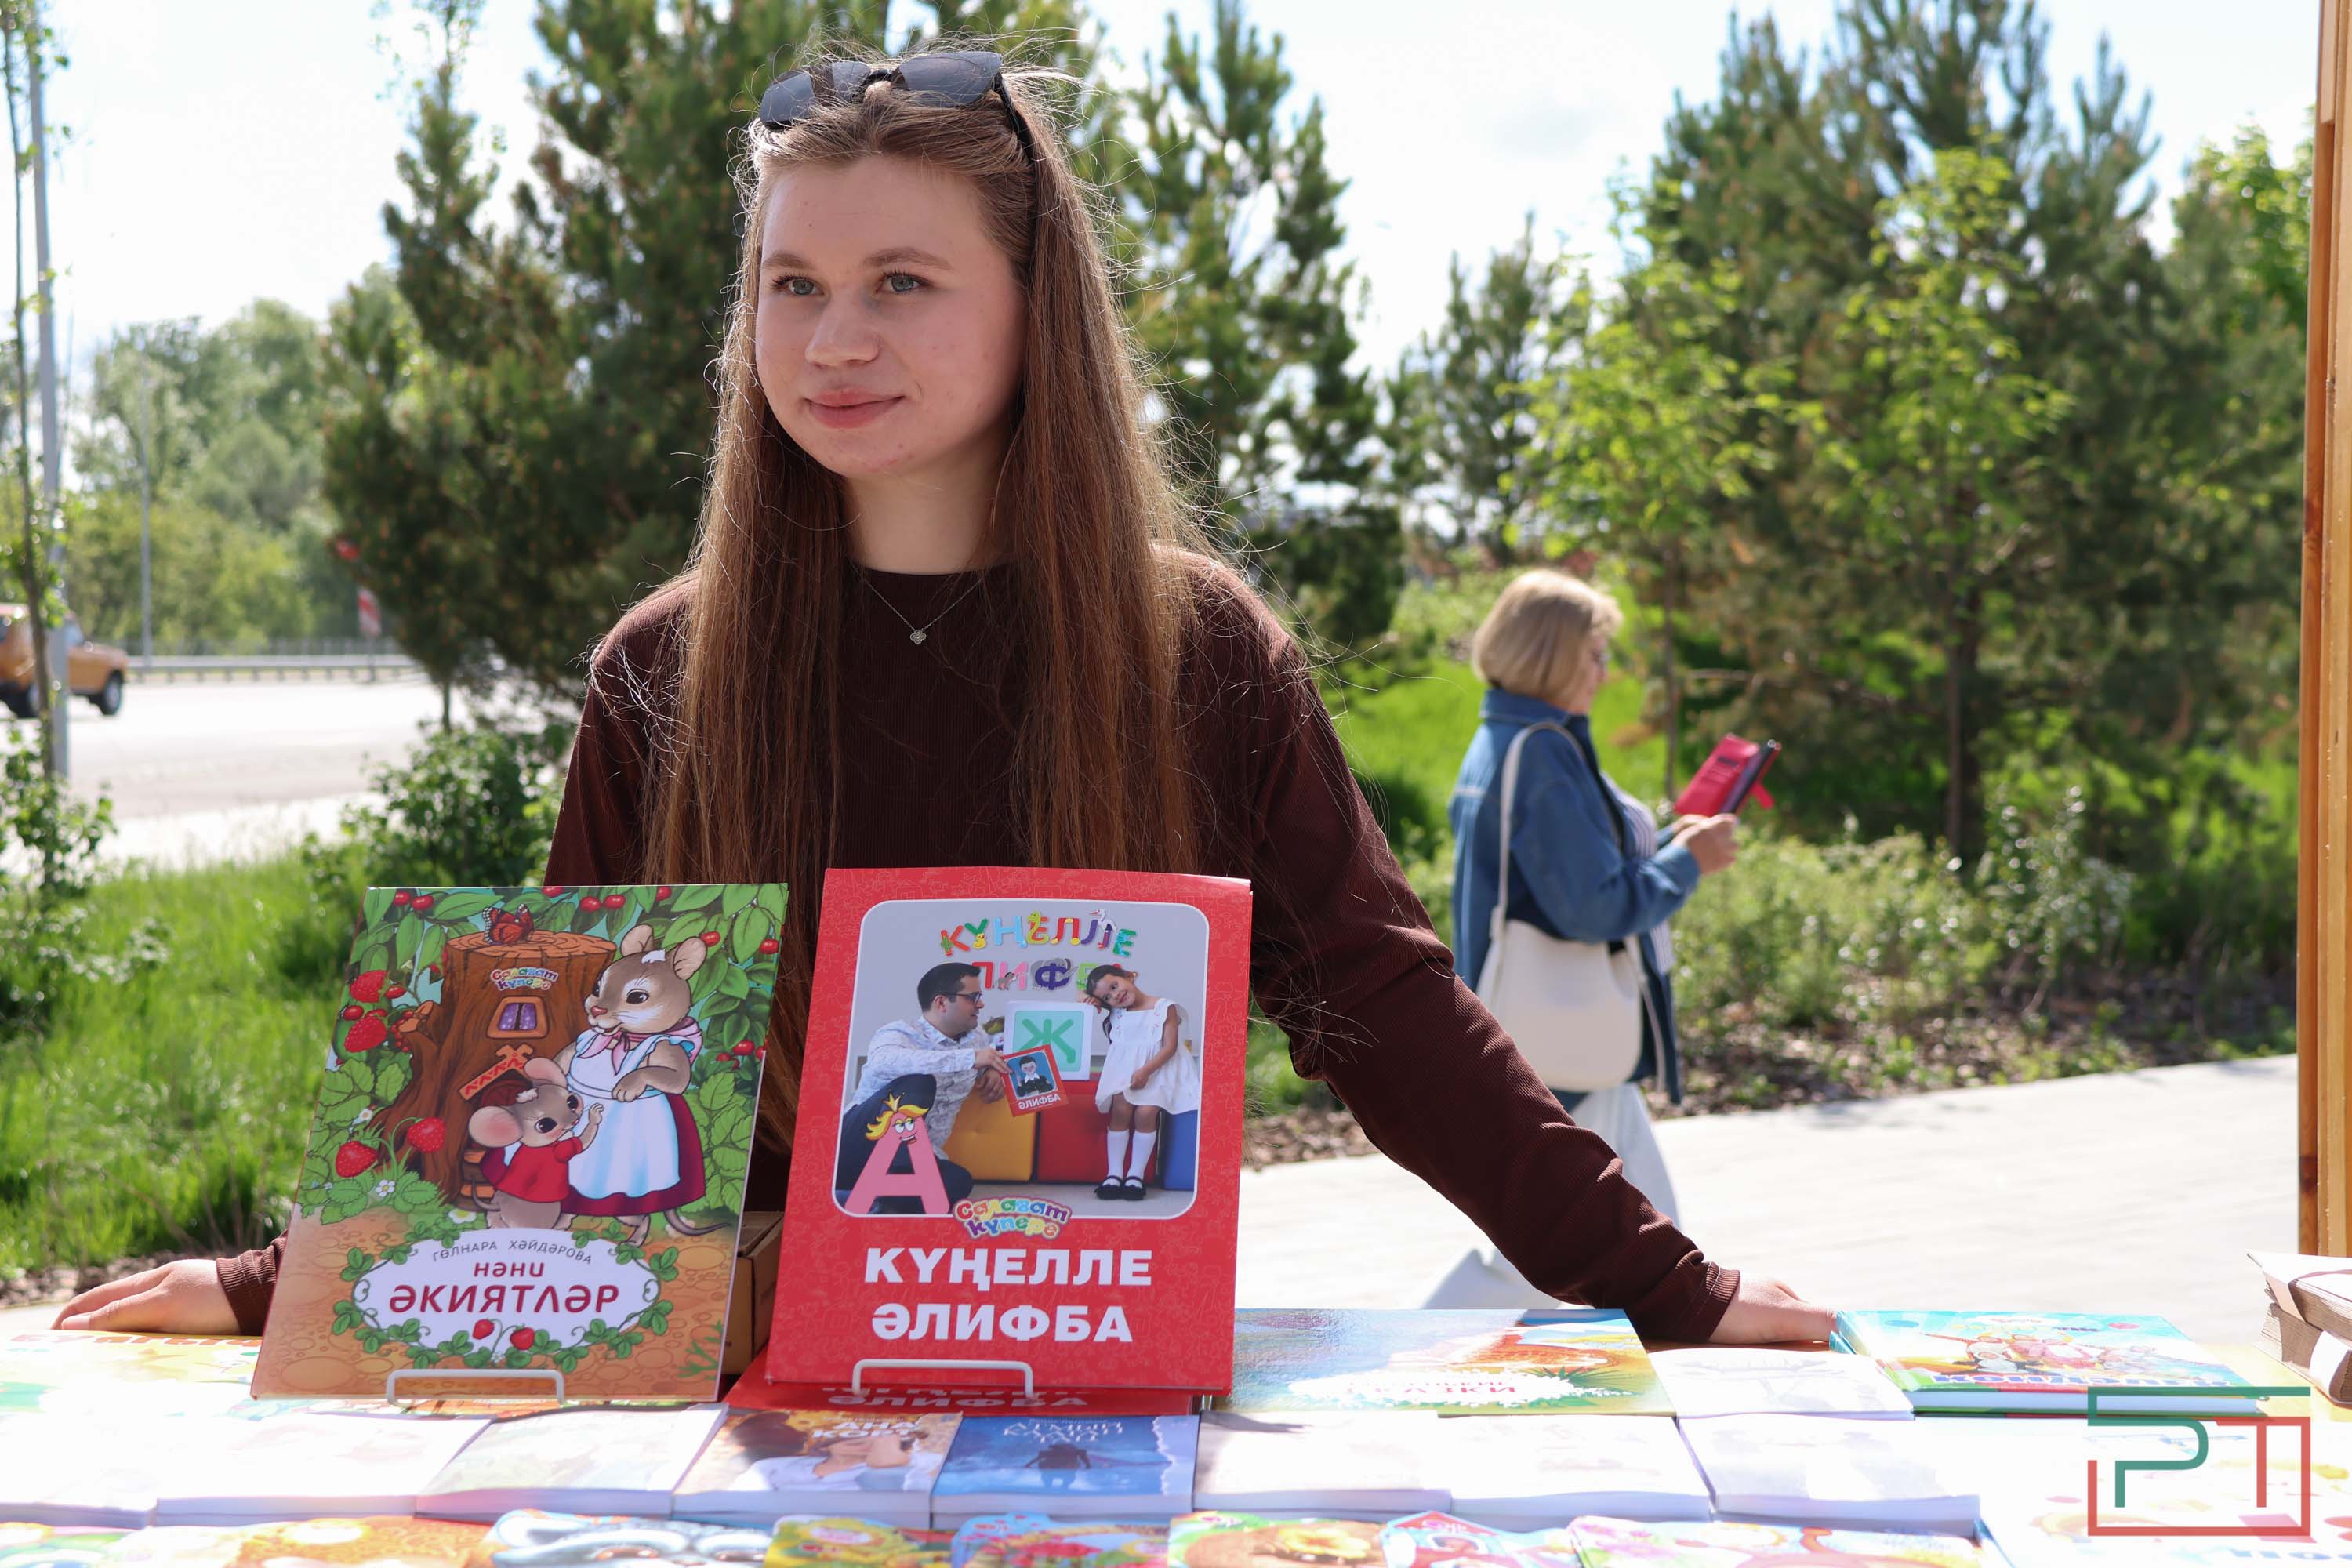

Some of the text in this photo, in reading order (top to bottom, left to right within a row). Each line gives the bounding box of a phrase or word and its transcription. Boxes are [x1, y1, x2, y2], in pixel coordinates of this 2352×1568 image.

[1021, 1018, 1076, 1064] Ж
[432, 1240, 593, 1265] ГӨЛНАРА ХӘЙДӘРОВА
[865, 1247, 1152, 1292] КҮҢЕЛЛЕ
[389, 1284, 620, 1313] ӘКИЯТЛӘР
[871, 1303, 1134, 1343] ӘЛИФБА
